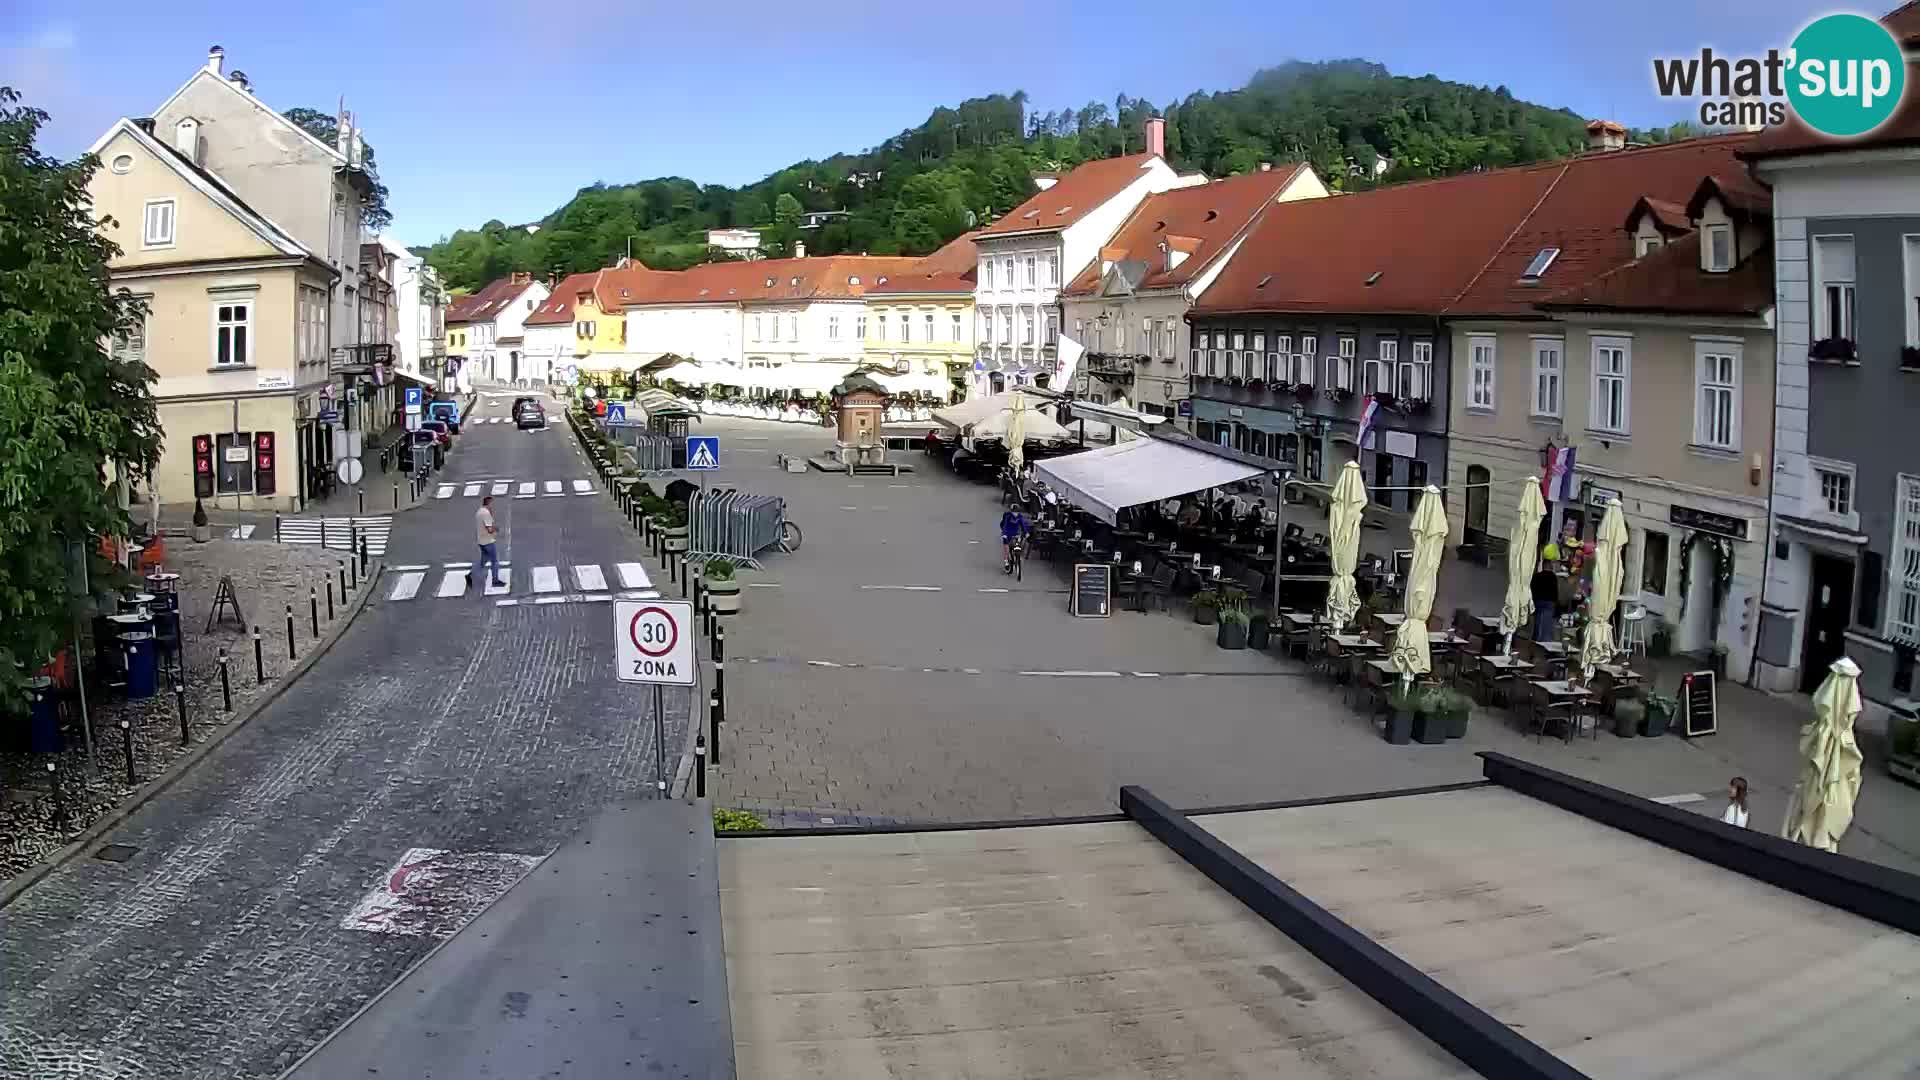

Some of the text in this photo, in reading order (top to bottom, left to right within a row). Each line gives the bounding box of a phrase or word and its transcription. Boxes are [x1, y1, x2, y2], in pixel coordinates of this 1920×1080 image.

[409, 391, 418, 403] P
[642, 623, 667, 643] 30
[632, 660, 678, 676] ZONA
